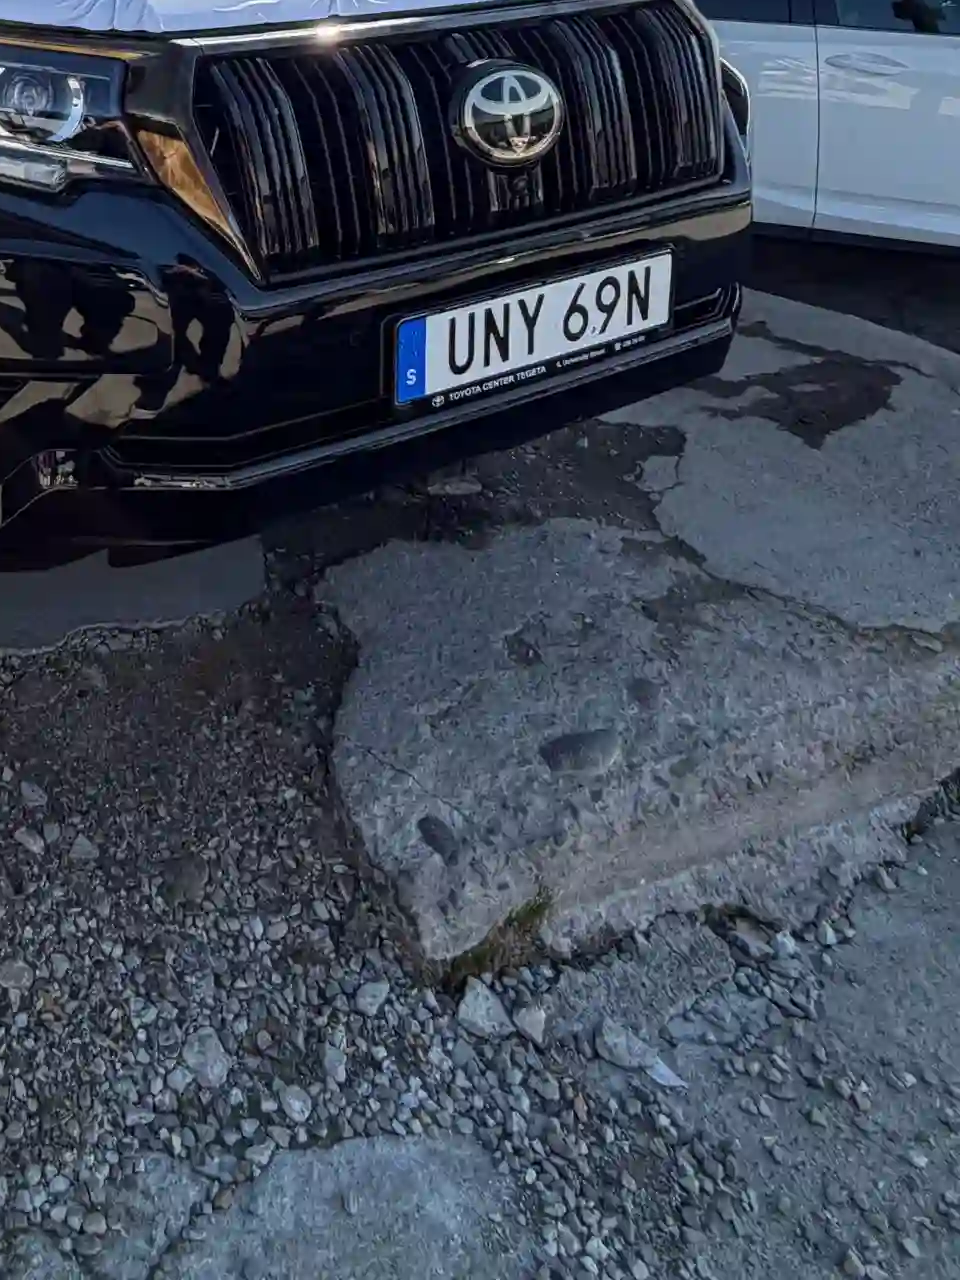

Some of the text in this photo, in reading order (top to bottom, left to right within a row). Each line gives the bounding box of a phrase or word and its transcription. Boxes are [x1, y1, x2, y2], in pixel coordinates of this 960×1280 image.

[448, 266, 651, 375] UNY 69N
[405, 368, 417, 385] S
[449, 385, 482, 401] TOYOTA
[482, 374, 515, 391] CENTER
